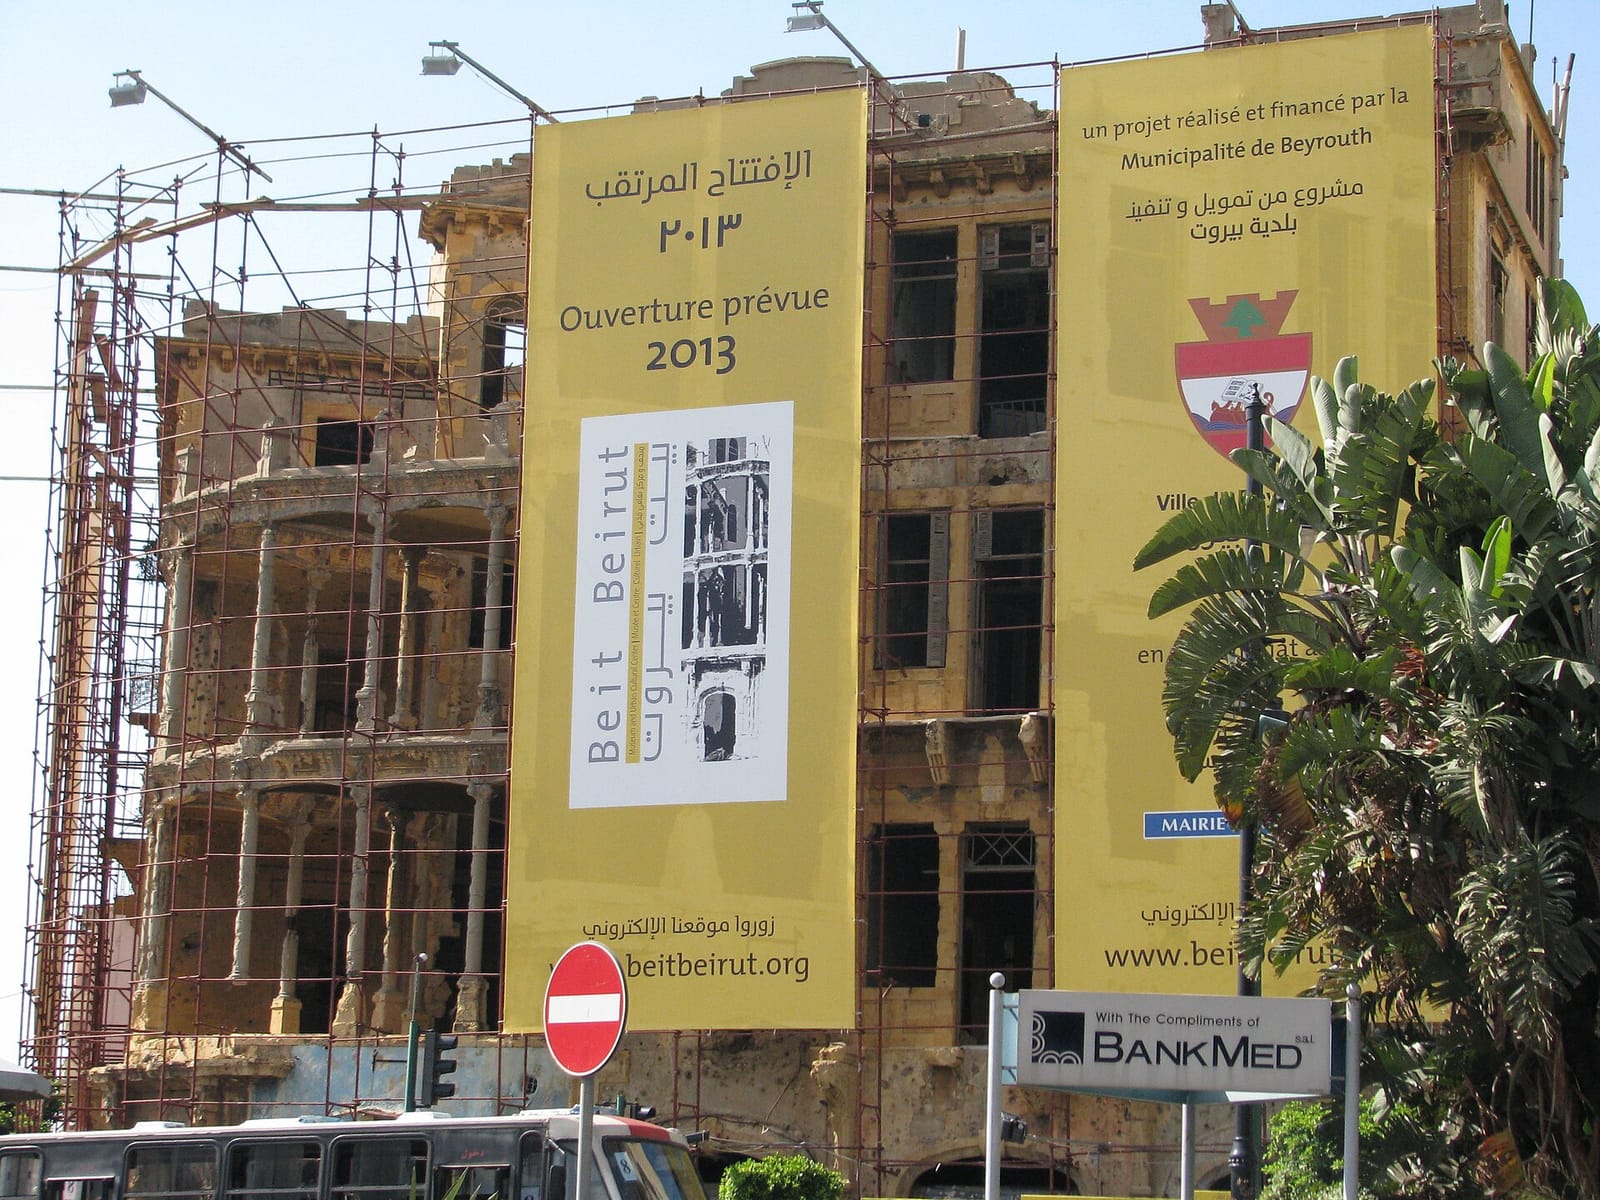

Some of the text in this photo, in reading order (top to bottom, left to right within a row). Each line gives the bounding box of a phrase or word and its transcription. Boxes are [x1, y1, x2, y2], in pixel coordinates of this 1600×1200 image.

[1083, 87, 1408, 141] un projet réalisé et financé par la
[1122, 127, 1371, 170] Municipalité de Beyrouth
[586, 150, 810, 206] الإفتتاح المرتقب
[1195, 190, 1253, 216] تمويل
[1259, 192, 1286, 210] من
[1294, 179, 1363, 207] مشروع
[1177, 201, 1187, 218] و
[660, 214, 742, 253] ٢٠١٣
[1191, 213, 1296, 244] بلدية بيروت
[561, 286, 829, 331] Ouverture prévue
[647, 336, 736, 374] 2013
[589, 446, 628, 763] Beit Beirut
[1138, 650, 1163, 663] en
[1162, 817, 1225, 831] MAIRIE
[583, 915, 774, 940] زوروا موقعنا الإلكتروني
[1142, 902, 1233, 926] الإلكتروني
[549, 953, 809, 982] beitbeirut.org
[1096, 1012, 1259, 1027] With The Compliments of
